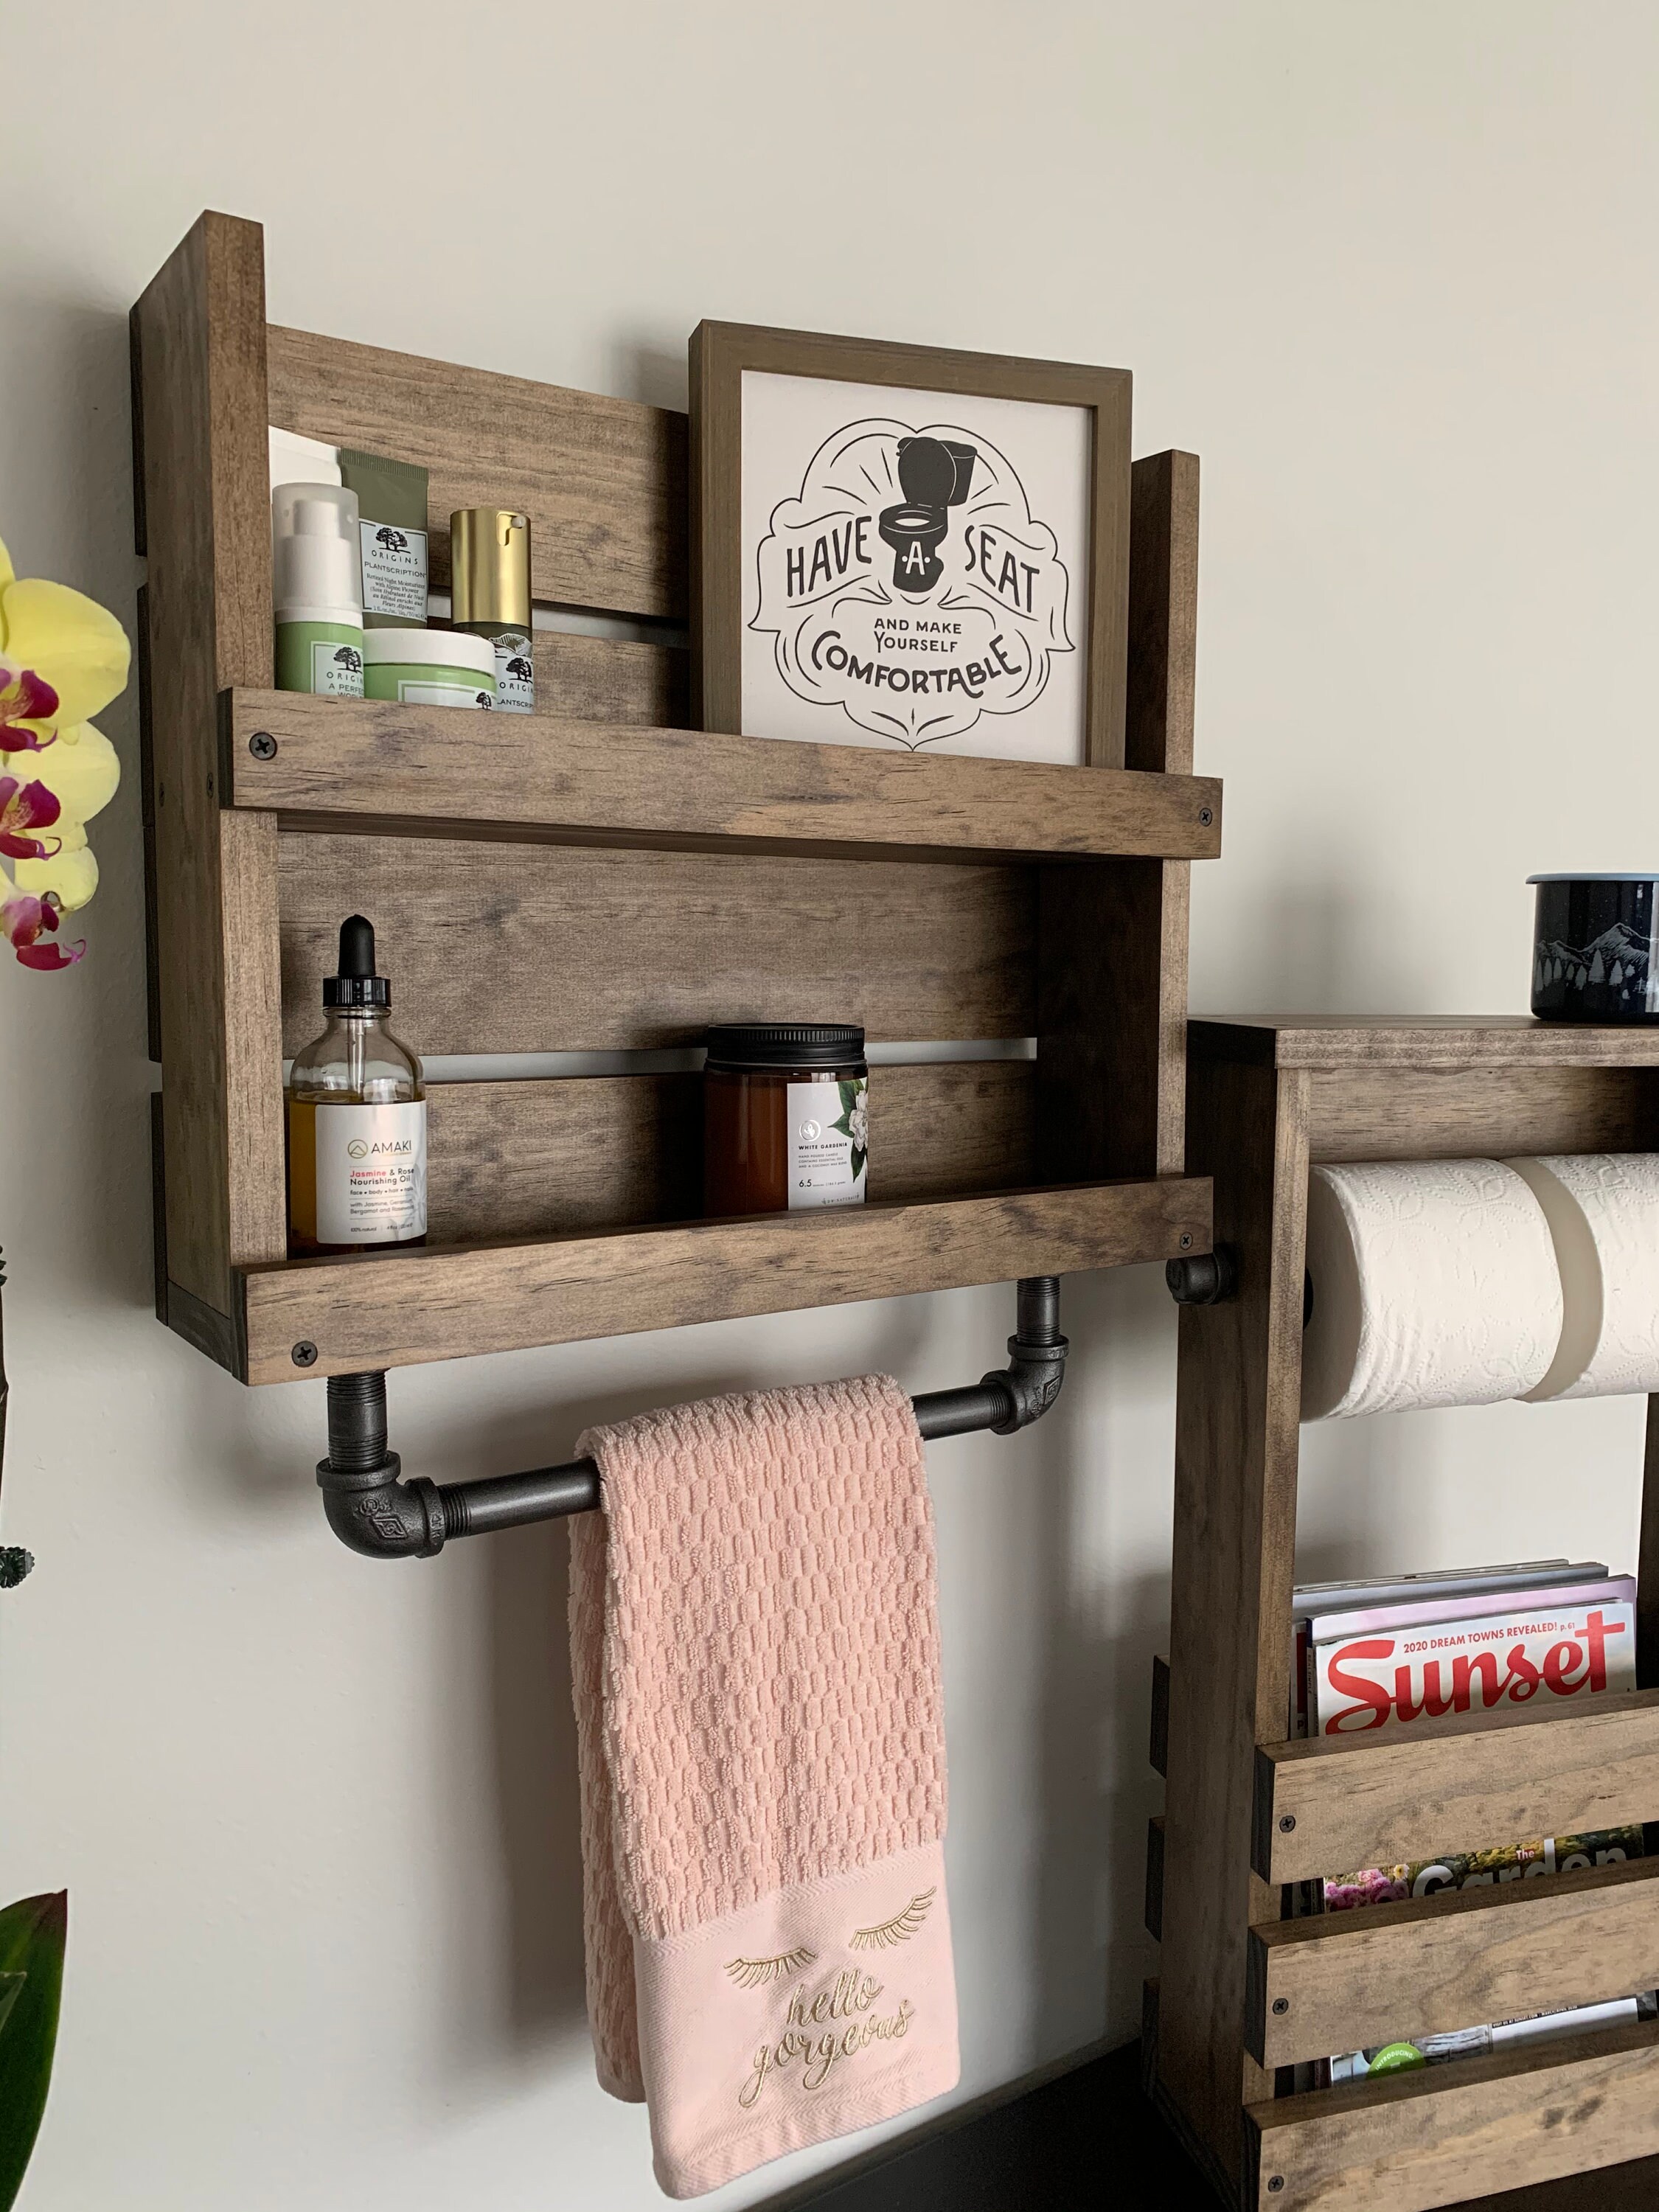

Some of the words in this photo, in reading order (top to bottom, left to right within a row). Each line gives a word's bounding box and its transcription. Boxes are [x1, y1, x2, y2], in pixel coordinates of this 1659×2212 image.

[371, 549, 418, 565] ORIGINS
[787, 515, 872, 598] HAVE
[905, 540, 926, 576] A
[964, 525, 1040, 613] SEAT
[364, 561, 425, 579] PLANTSCRIPTION
[874, 618, 909, 632] AND
[916, 621, 962, 636] MAKE
[874, 631, 959, 653] YOURSELF
[812, 630, 1023, 699] COMFORTABLE
[371, 1140, 412, 1154] AMAKI
[349, 1170, 386, 1178] Jasmine
[350, 1178, 397, 1186] Nourishing
[799, 1179, 812, 1188] 6.5
[1403, 1641, 1428, 1654] 2020
[1430, 1635, 1466, 1649] DREAM
[1467, 1629, 1505, 1643] TOWNS
[1507, 1621, 1557, 1637] REVEALED!
[1325, 1610, 1625, 1736] Sunset
[1516, 1848, 1535, 1861] The
[787, 1968, 885, 2027] hello
[739, 1999, 915, 2109] gorgeous
